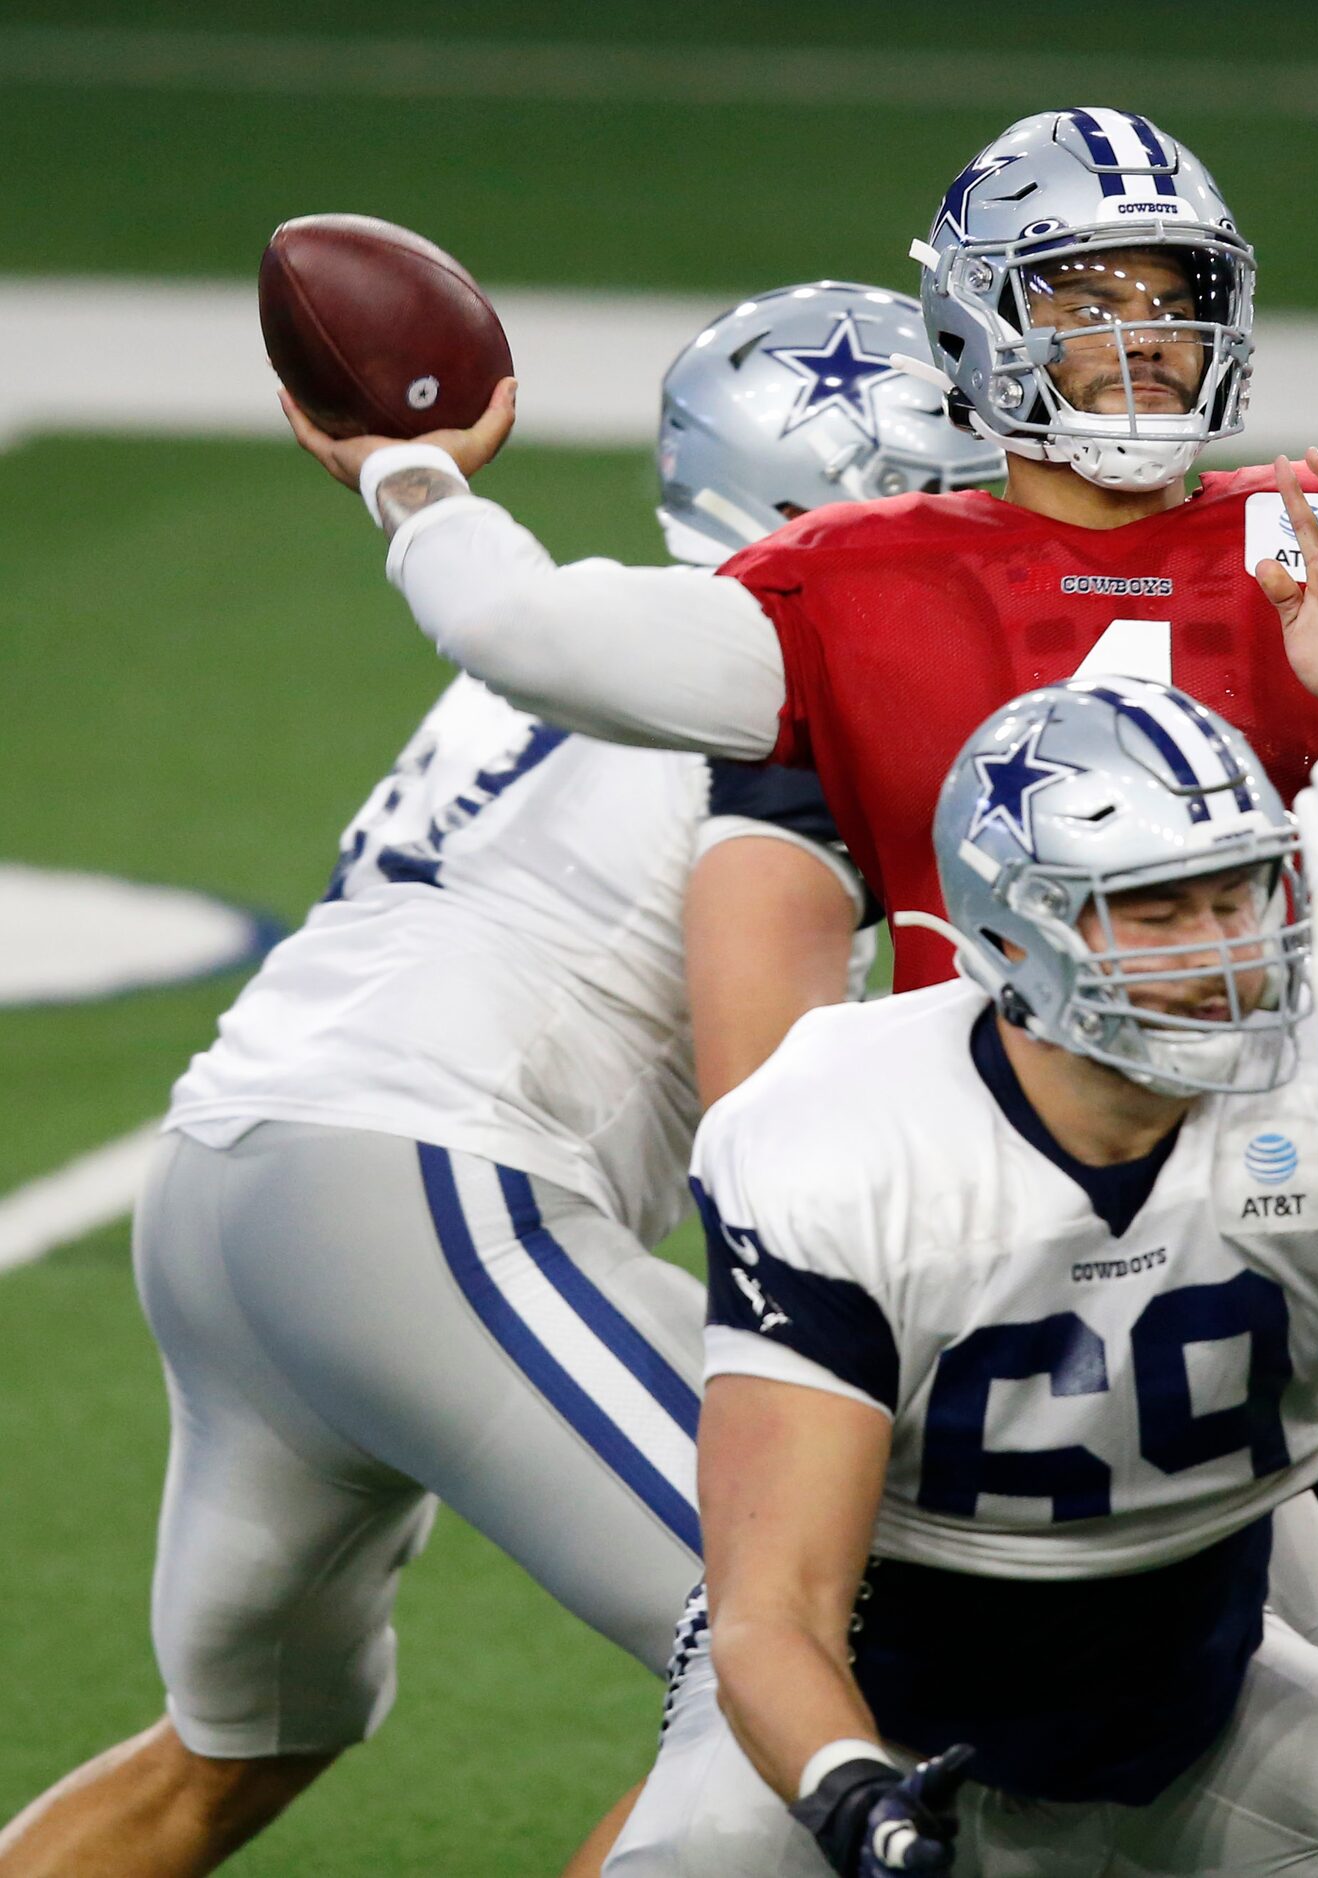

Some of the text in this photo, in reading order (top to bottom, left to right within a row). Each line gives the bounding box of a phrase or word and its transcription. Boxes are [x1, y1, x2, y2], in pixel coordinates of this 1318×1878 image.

[1118, 203, 1178, 214] COWBOYS
[1275, 549, 1302, 568] AT
[1061, 575, 1172, 596] COWBOYS
[1241, 1194, 1307, 1219] AT&T
[1071, 1247, 1168, 1282] COWBOYS
[918, 1268, 1293, 1523] 69
